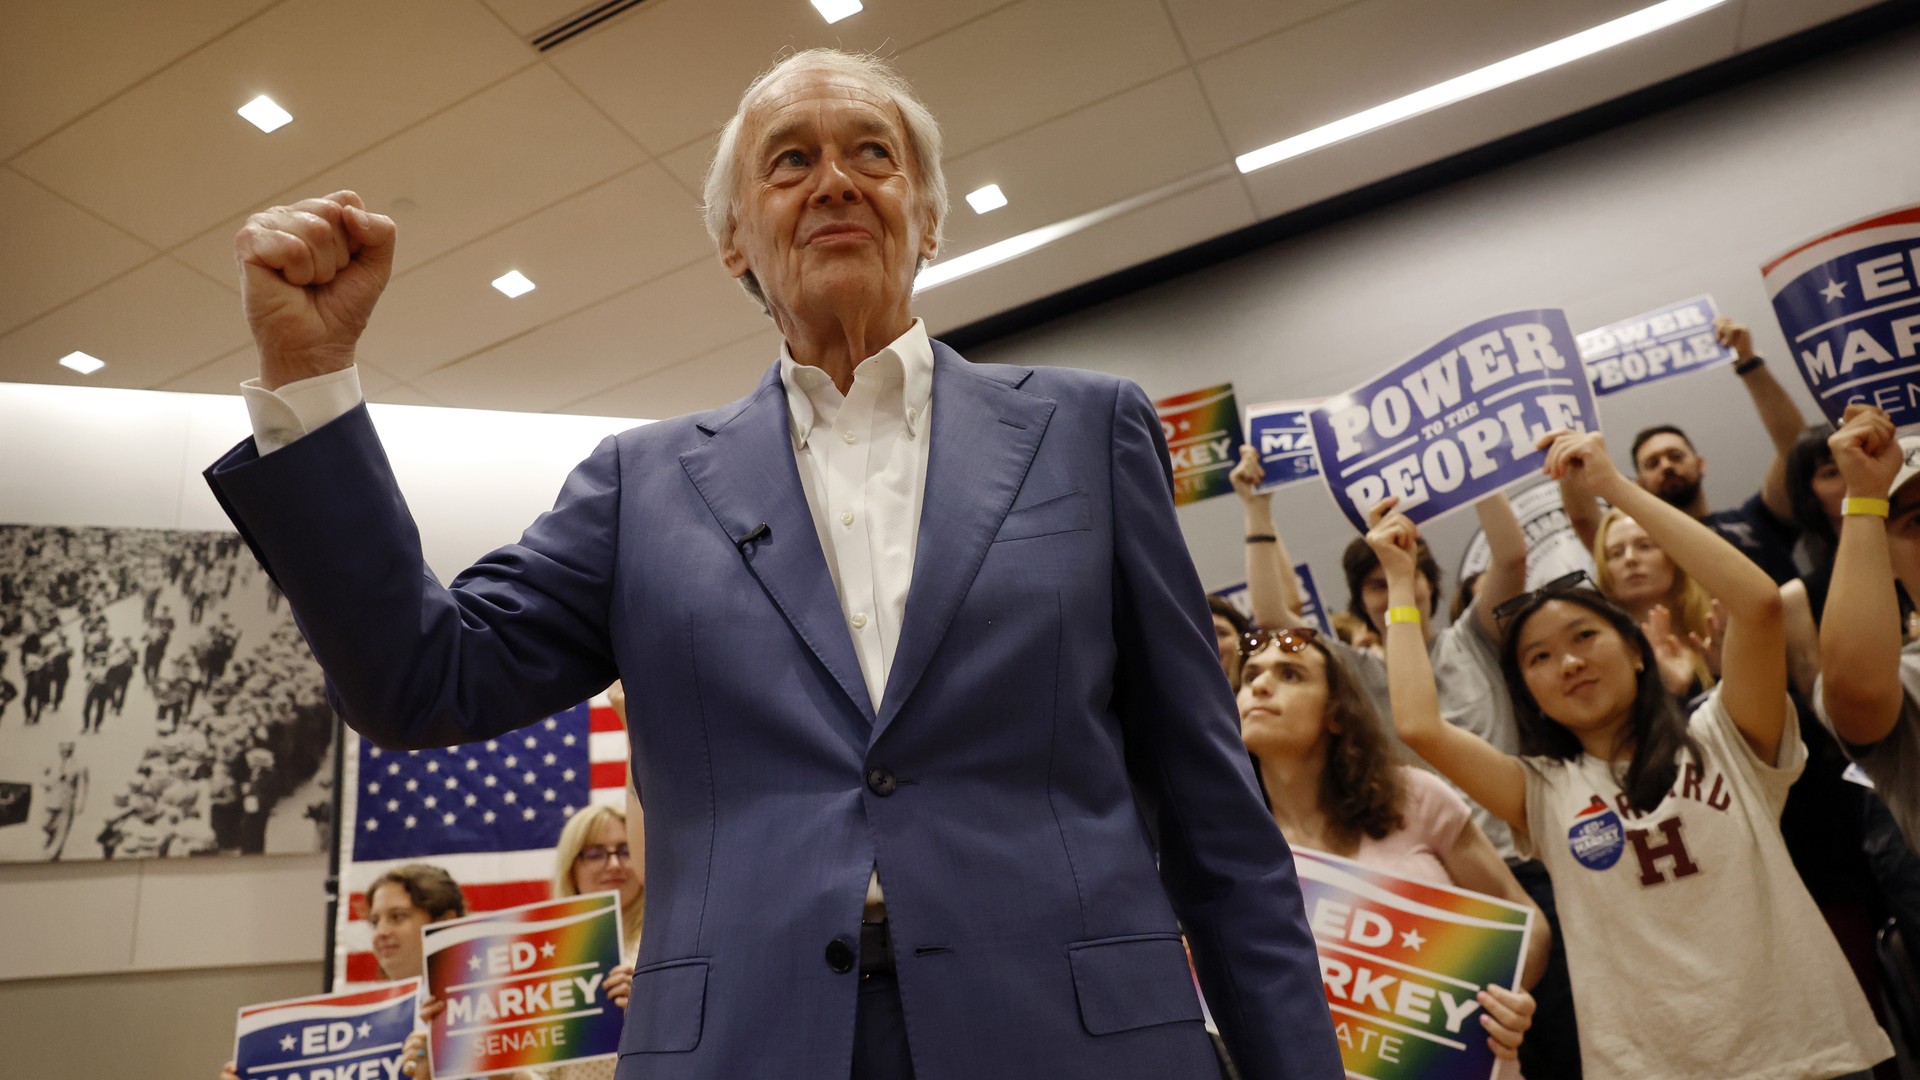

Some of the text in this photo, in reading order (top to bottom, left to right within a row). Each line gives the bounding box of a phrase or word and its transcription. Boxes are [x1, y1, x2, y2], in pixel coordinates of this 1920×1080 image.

[1857, 247, 1920, 301] E
[1329, 323, 1565, 462] POWER
[1421, 402, 1479, 440] TO THE
[1625, 816, 1699, 886] H
[1312, 897, 1393, 948] ED
[487, 942, 537, 975] ED
[446, 973, 603, 1026] MARKEY
[1319, 955, 1480, 1033] RKEY
[302, 1021, 354, 1056] ED
[472, 1024, 567, 1057] SENATE
[1336, 1022, 1404, 1064] ATE
